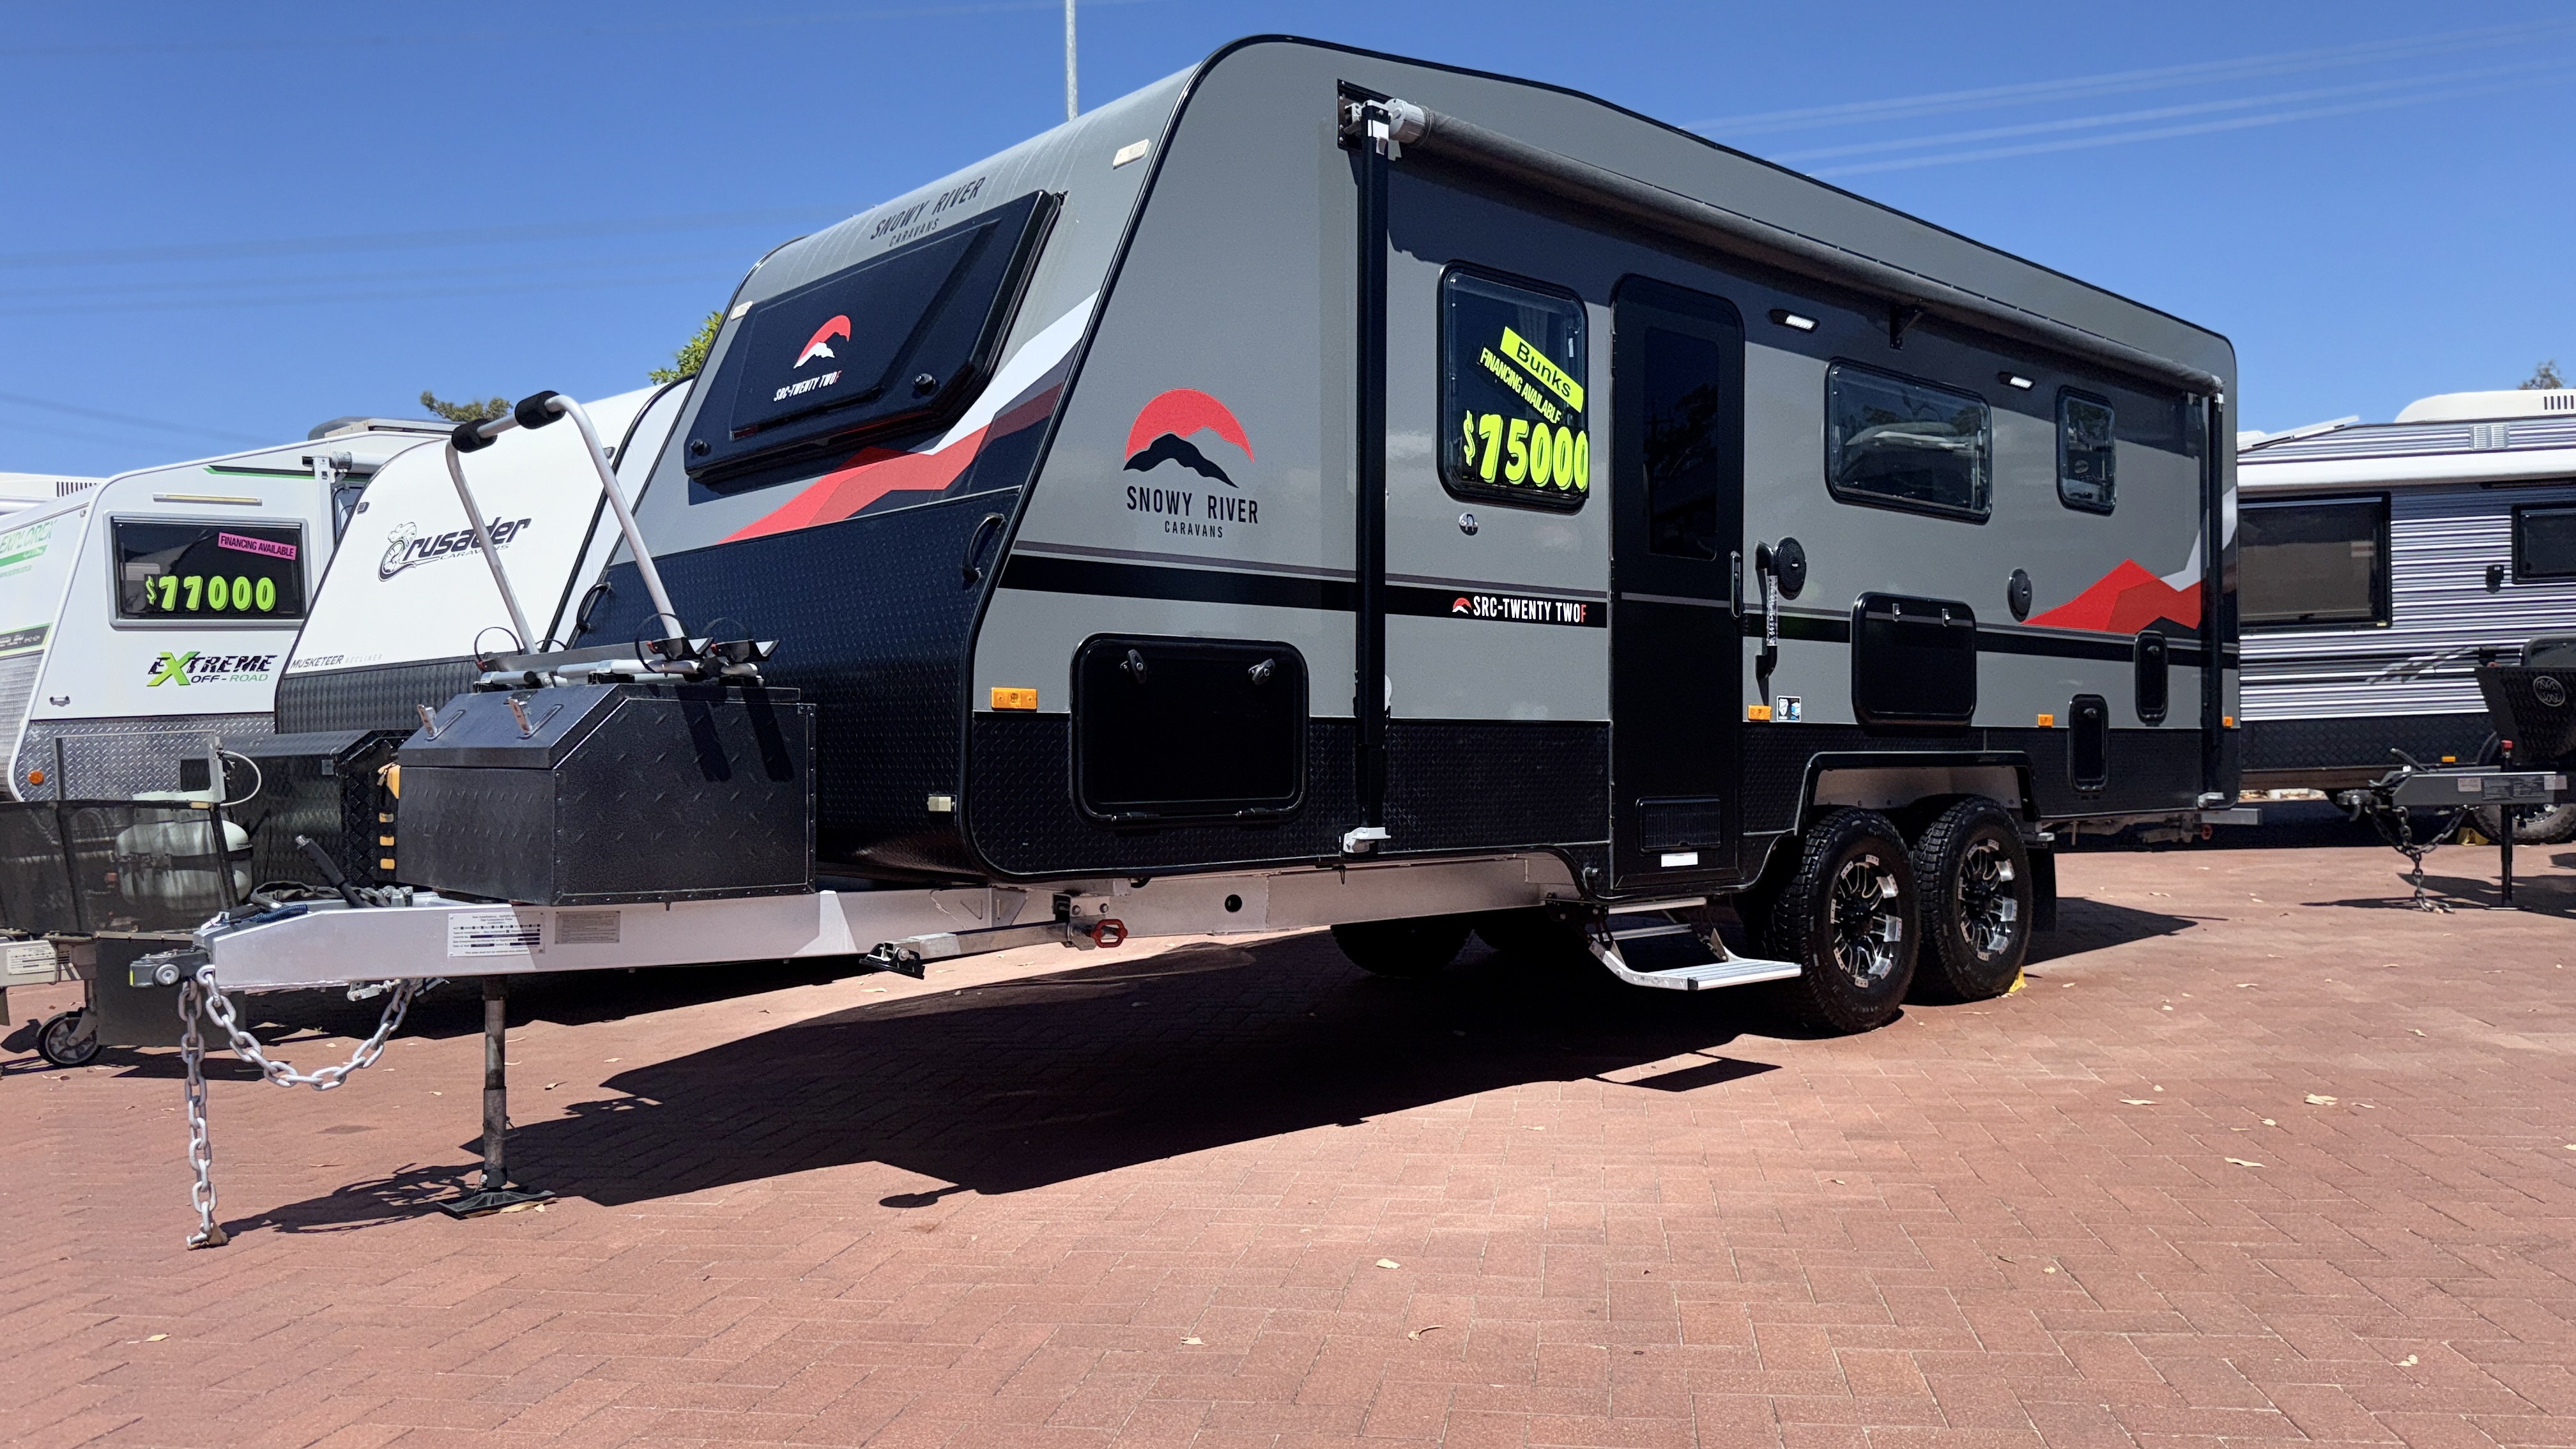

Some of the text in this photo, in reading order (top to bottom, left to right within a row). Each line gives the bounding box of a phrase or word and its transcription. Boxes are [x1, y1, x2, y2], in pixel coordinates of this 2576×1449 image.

[870, 176, 986, 240] SNOWY RIVER
[889, 218, 939, 247] CARAVANS
[1480, 347, 1523, 394] FINANCING
[1516, 341, 1571, 397] Bunks
[1463, 410, 1589, 492] $75000
[1126, 486, 1258, 524] SNOWY RIVER
[220, 535, 295, 556] FINANCING AVAILABLE
[1165, 520, 1223, 538] CARAVANS
[146, 575, 276, 611] $77000
[1473, 595, 1552, 620] SRC-TWENTY
[146, 652, 278, 687] EXTREME
[290, 654, 383, 669] MUSKETEER RECLINER
